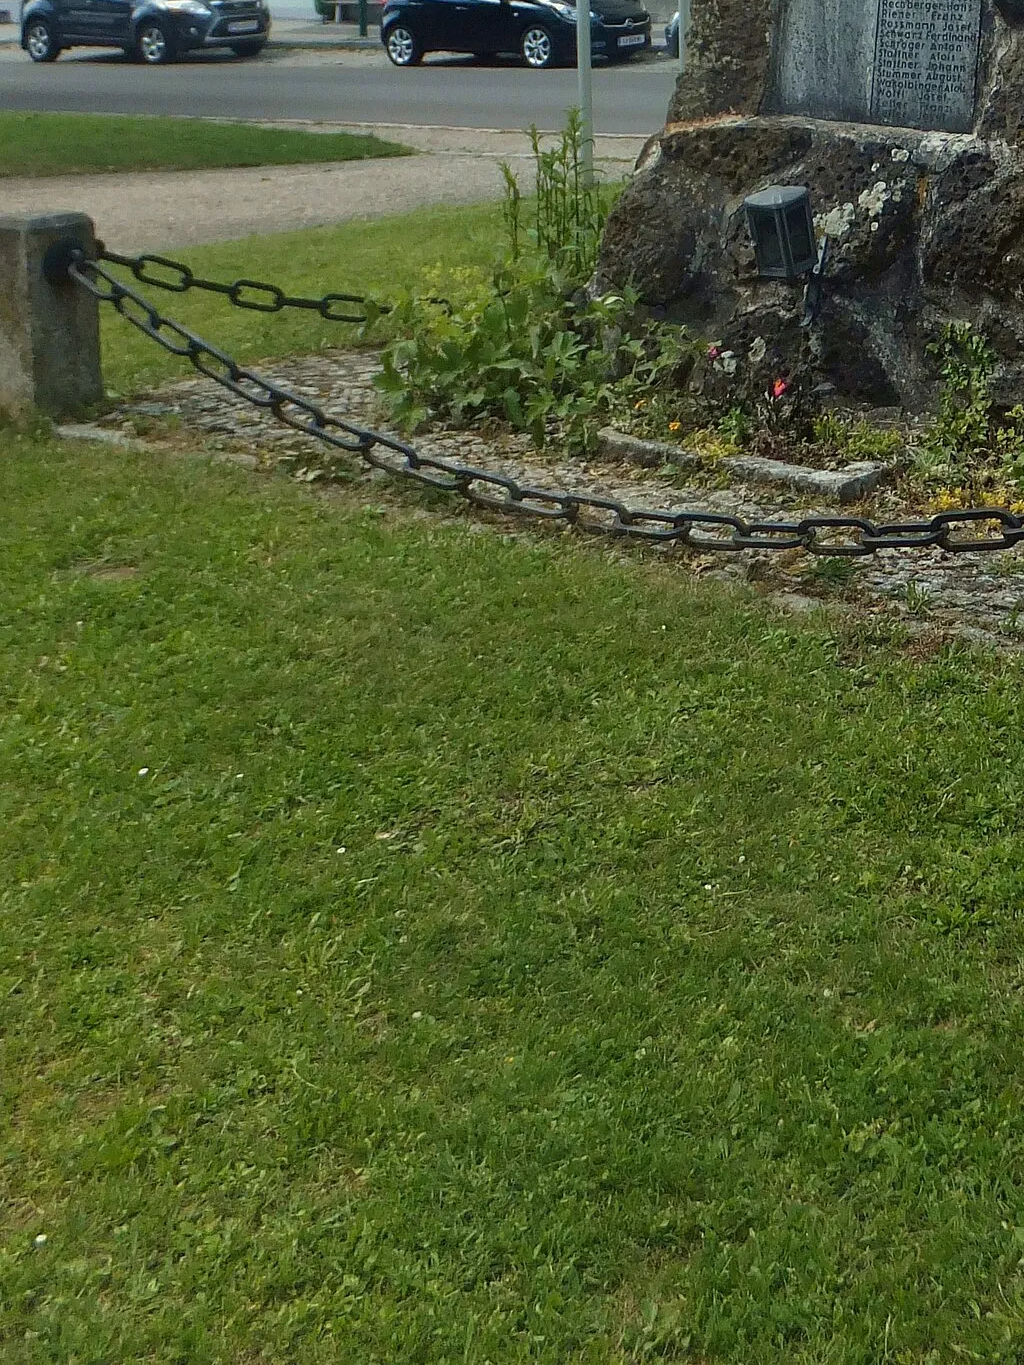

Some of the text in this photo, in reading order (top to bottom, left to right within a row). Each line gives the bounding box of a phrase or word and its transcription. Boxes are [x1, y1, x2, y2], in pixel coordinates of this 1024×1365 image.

[882, 8, 963, 21] Riener Franz
[880, 18, 972, 32] Rossmann Josef
[880, 27, 977, 42] Schwarz Ferdinand
[930, 41, 962, 51] Anton
[930, 52, 955, 61] Alois
[926, 61, 966, 72] Johann
[877, 67, 961, 84] Stummer August
[917, 92, 947, 102] Josef
